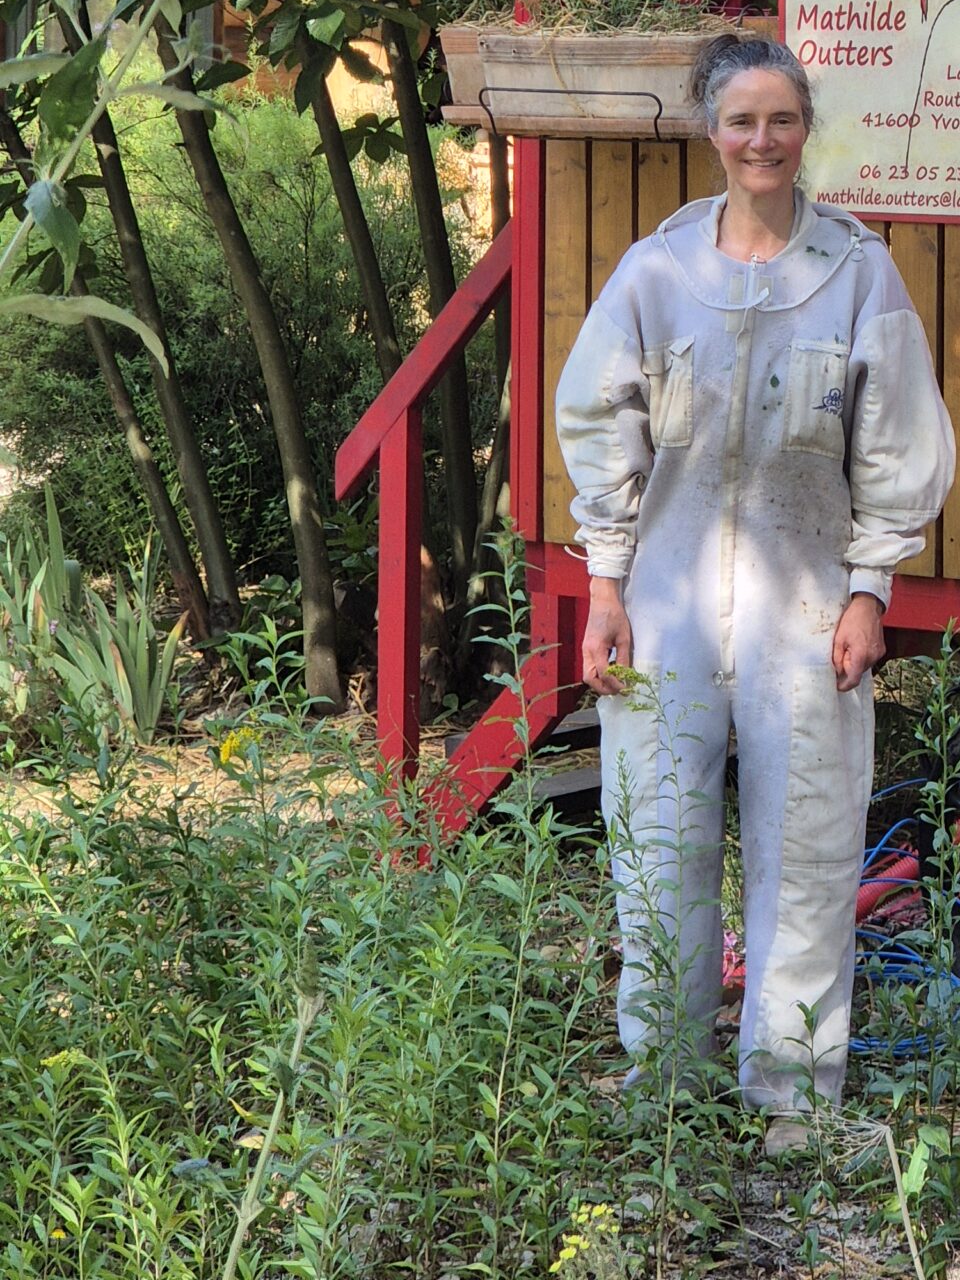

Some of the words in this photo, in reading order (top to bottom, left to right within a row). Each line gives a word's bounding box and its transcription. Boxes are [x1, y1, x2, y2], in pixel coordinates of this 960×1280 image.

[797, 0, 907, 31] Mathilde
[799, 39, 894, 67] Outters
[862, 112, 921, 129] 41600
[859, 165, 881, 180] 06
[888, 165, 909, 180] 23
[916, 165, 939, 180] 05
